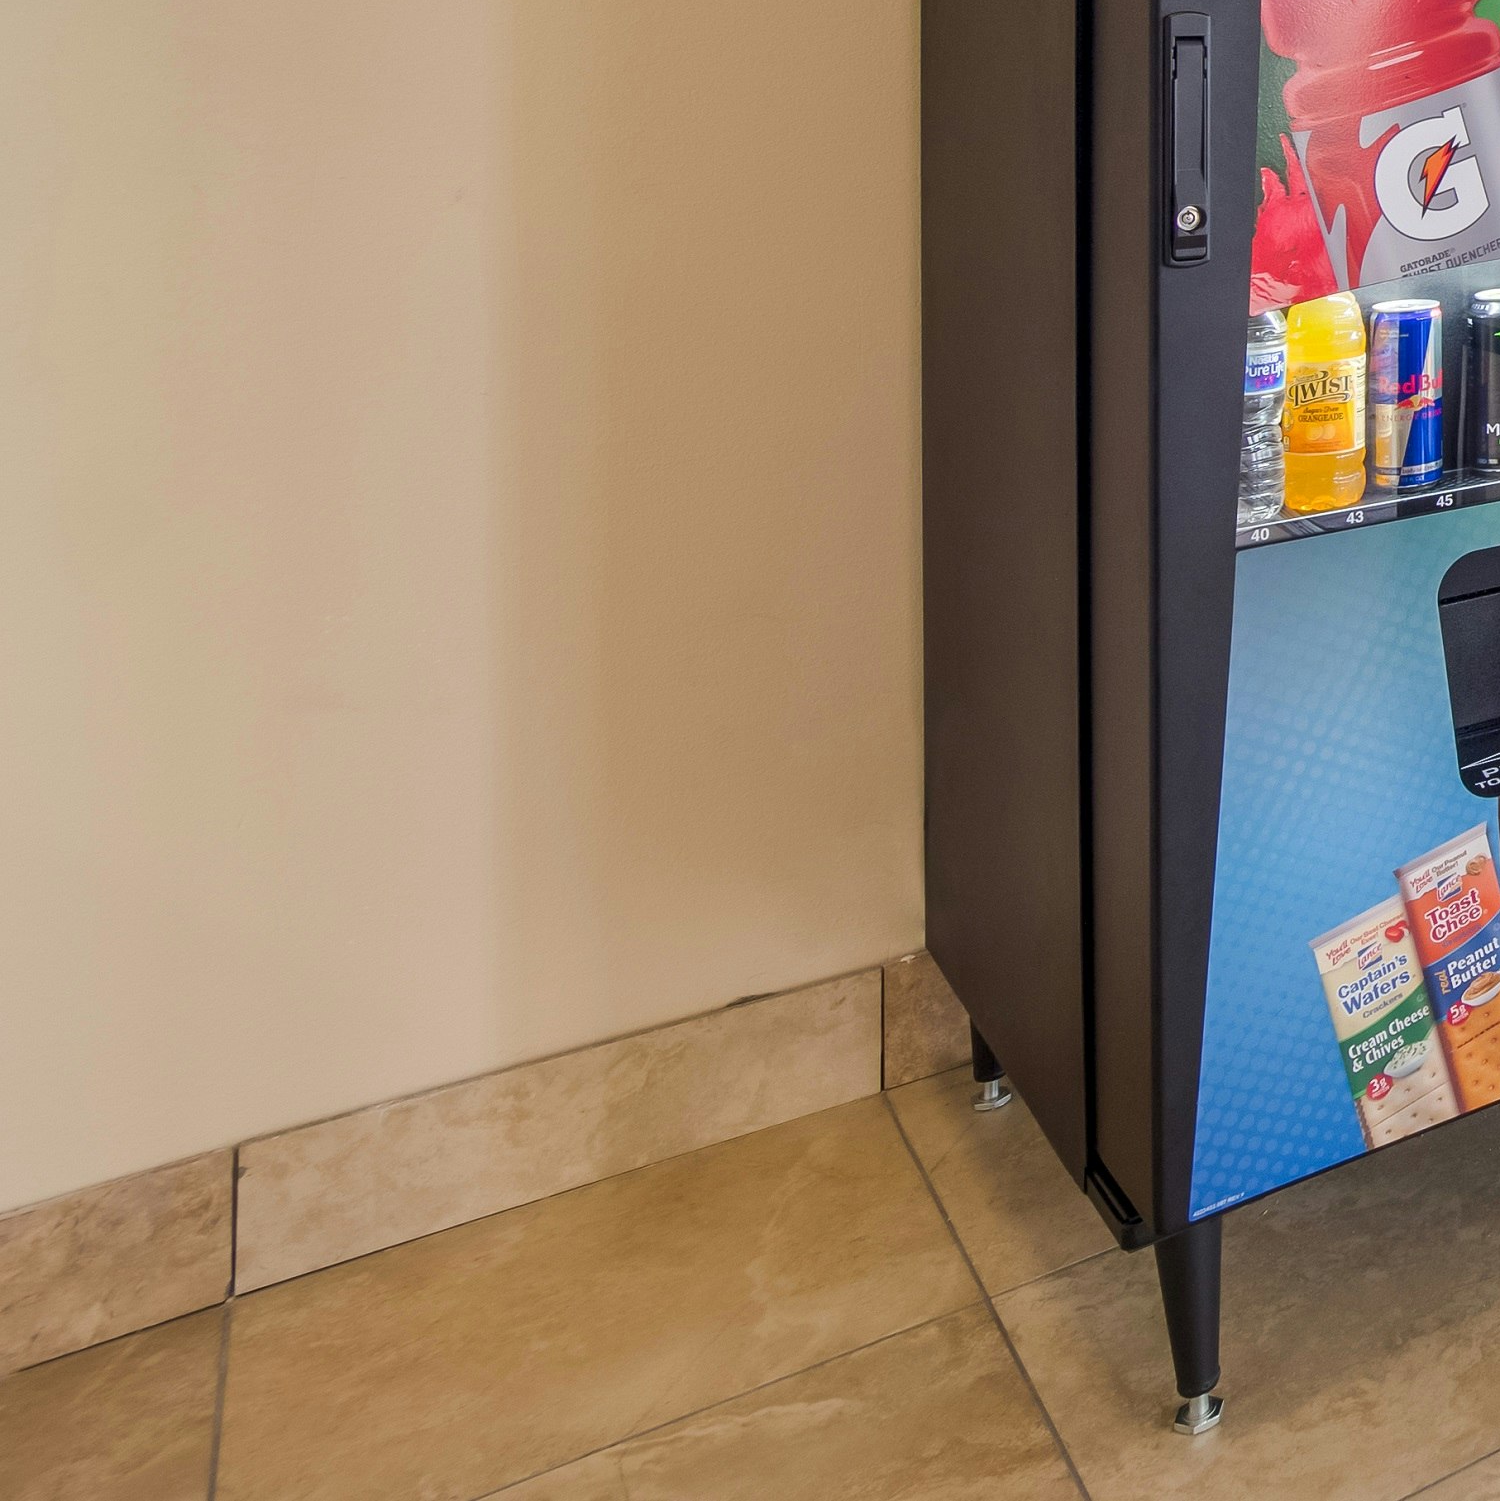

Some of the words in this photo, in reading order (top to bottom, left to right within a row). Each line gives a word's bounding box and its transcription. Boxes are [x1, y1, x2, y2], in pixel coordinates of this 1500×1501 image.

[1374, 104, 1491, 242] G
[1400, 249, 1451, 274] GATORADE
[1287, 374, 1353, 408] TWIST
[1378, 374, 1416, 395] Red
[1297, 412, 1344, 423] ORANGEADE
[1435, 494, 1454, 508] 45
[1346, 511, 1365, 525] 43
[1250, 527, 1270, 542] 40
[1424, 888, 1480, 928] Toast
[1431, 905, 1483, 943] Chee
[1357, 943, 1382, 970] Lance
[1447, 937, 1500, 975] Peanut
[1450, 953, 1498, 990] Butter
[1337, 953, 1409, 1000] Captain's
[1342, 969, 1411, 1016] Wafers
[1362, 992, 1404, 1020] Crackers
[1450, 1002, 1467, 1019] 5g
[1348, 1029, 1389, 1061] Cream
[1388, 1004, 1431, 1037] Cheese
[1351, 1058, 1365, 1074] &
[1365, 1034, 1406, 1067] Chives
[1369, 1076, 1388, 1094] 3g
